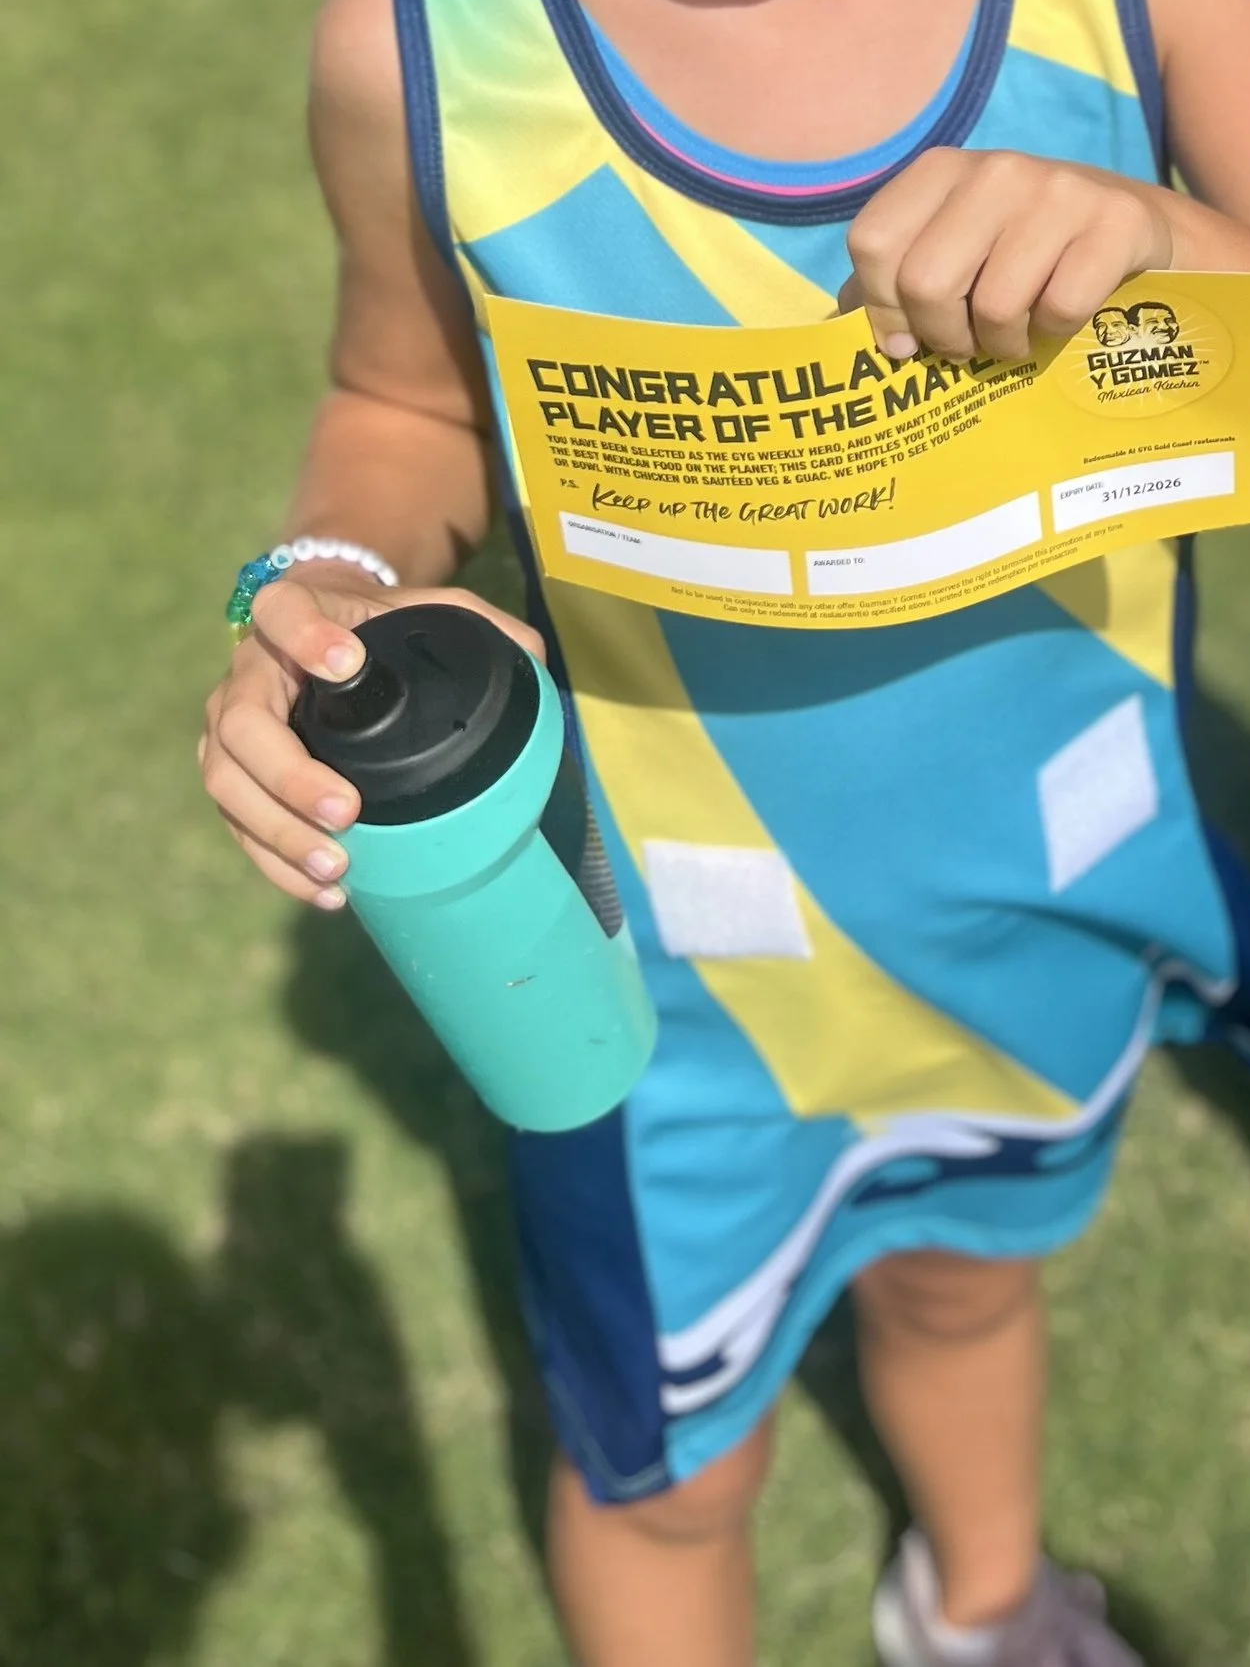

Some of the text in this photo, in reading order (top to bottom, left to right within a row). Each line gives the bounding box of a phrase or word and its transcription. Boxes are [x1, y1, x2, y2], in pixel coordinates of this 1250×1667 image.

[1087, 345, 1194, 371] GUZMAN
[1090, 361, 1199, 389] Y GOMEZ
[539, 400, 706, 442] PLAYER
[711, 414, 770, 443] OF
[780, 394, 877, 438] THE
[546, 434, 568, 446] YOU
[571, 437, 598, 449] HAVE
[600, 440, 628, 453] BEEN
[630, 445, 685, 459] SELECTED
[688, 450, 704, 460] AS
[705, 451, 728, 461] THE
[731, 450, 755, 462] GYG
[757, 448, 804, 460] WEEKLY
[809, 443, 845, 456] HERO,
[847, 435, 872, 450] AND
[874, 428, 892, 441] WE
[895, 413, 925, 434] WANT
[927, 405, 941, 419] TO
[944, 382, 985, 412] REWARD
[549, 377, 1034, 474] THE BEST MEXICAN FOOD ON THE PLANET; THIS CARD ENTITLES YOU TO ONE MINI BURRITO
[554, 414, 981, 486] OR BOWL WITH CHICKEN OR SAUTÉED VEG & GUAC. WE HOPE TO SEE YOU SOON.
[1102, 477, 1181, 502] 31/12/2026
